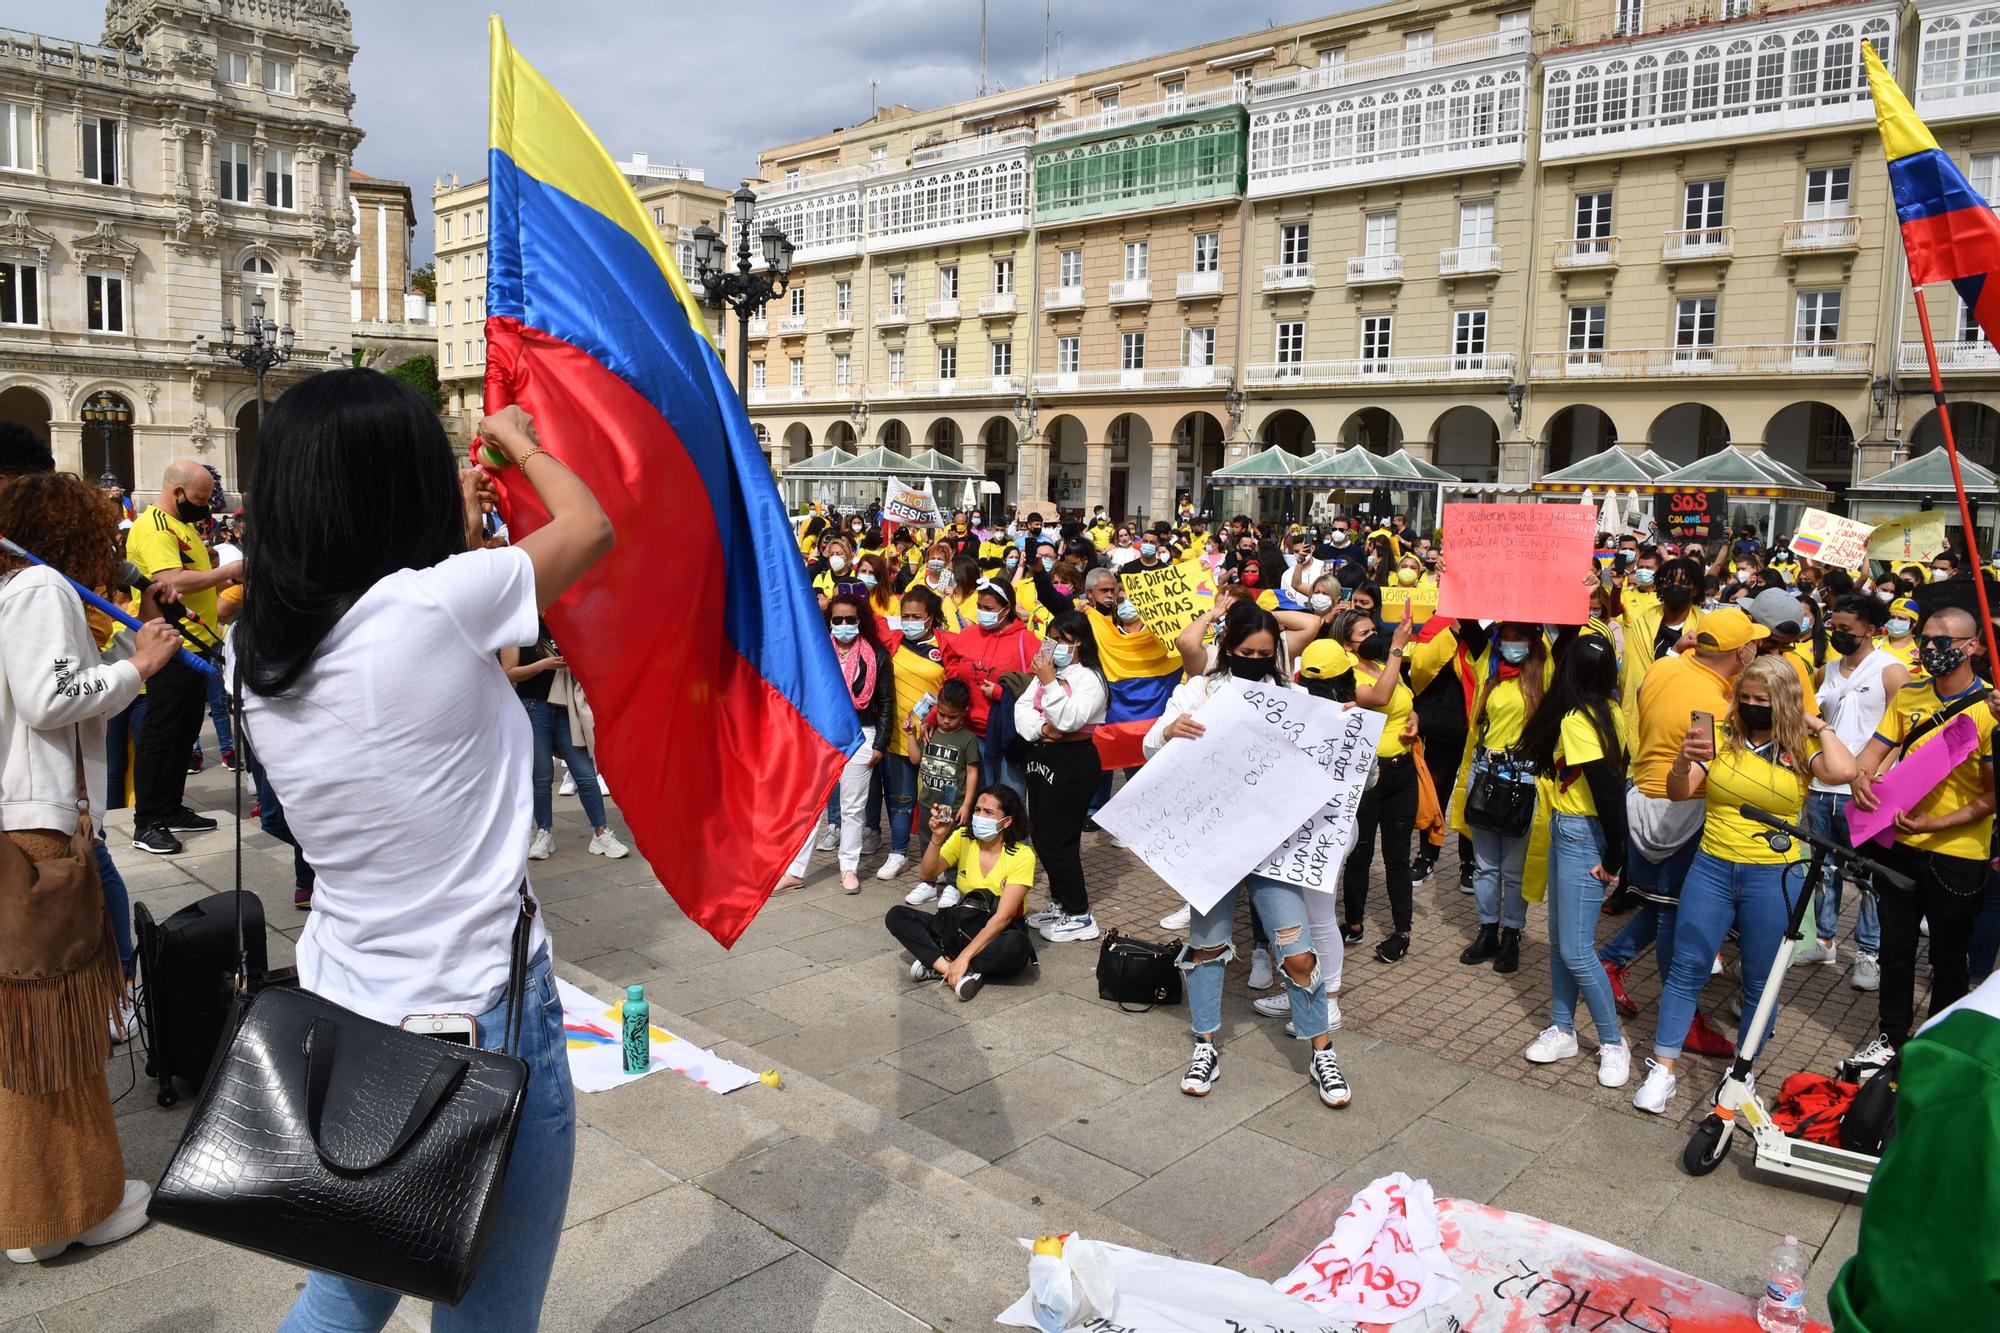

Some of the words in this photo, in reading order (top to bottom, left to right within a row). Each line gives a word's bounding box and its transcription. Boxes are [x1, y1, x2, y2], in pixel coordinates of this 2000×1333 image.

[1125, 575, 1143, 592] QUE
[1129, 588, 1160, 607] ESTAR
[1149, 618, 1182, 636] ATAN
[1332, 711, 1367, 782] IZQUIERDA
[1026, 760, 1055, 786] ATLANTA
[1342, 783, 1363, 824] AHORA
